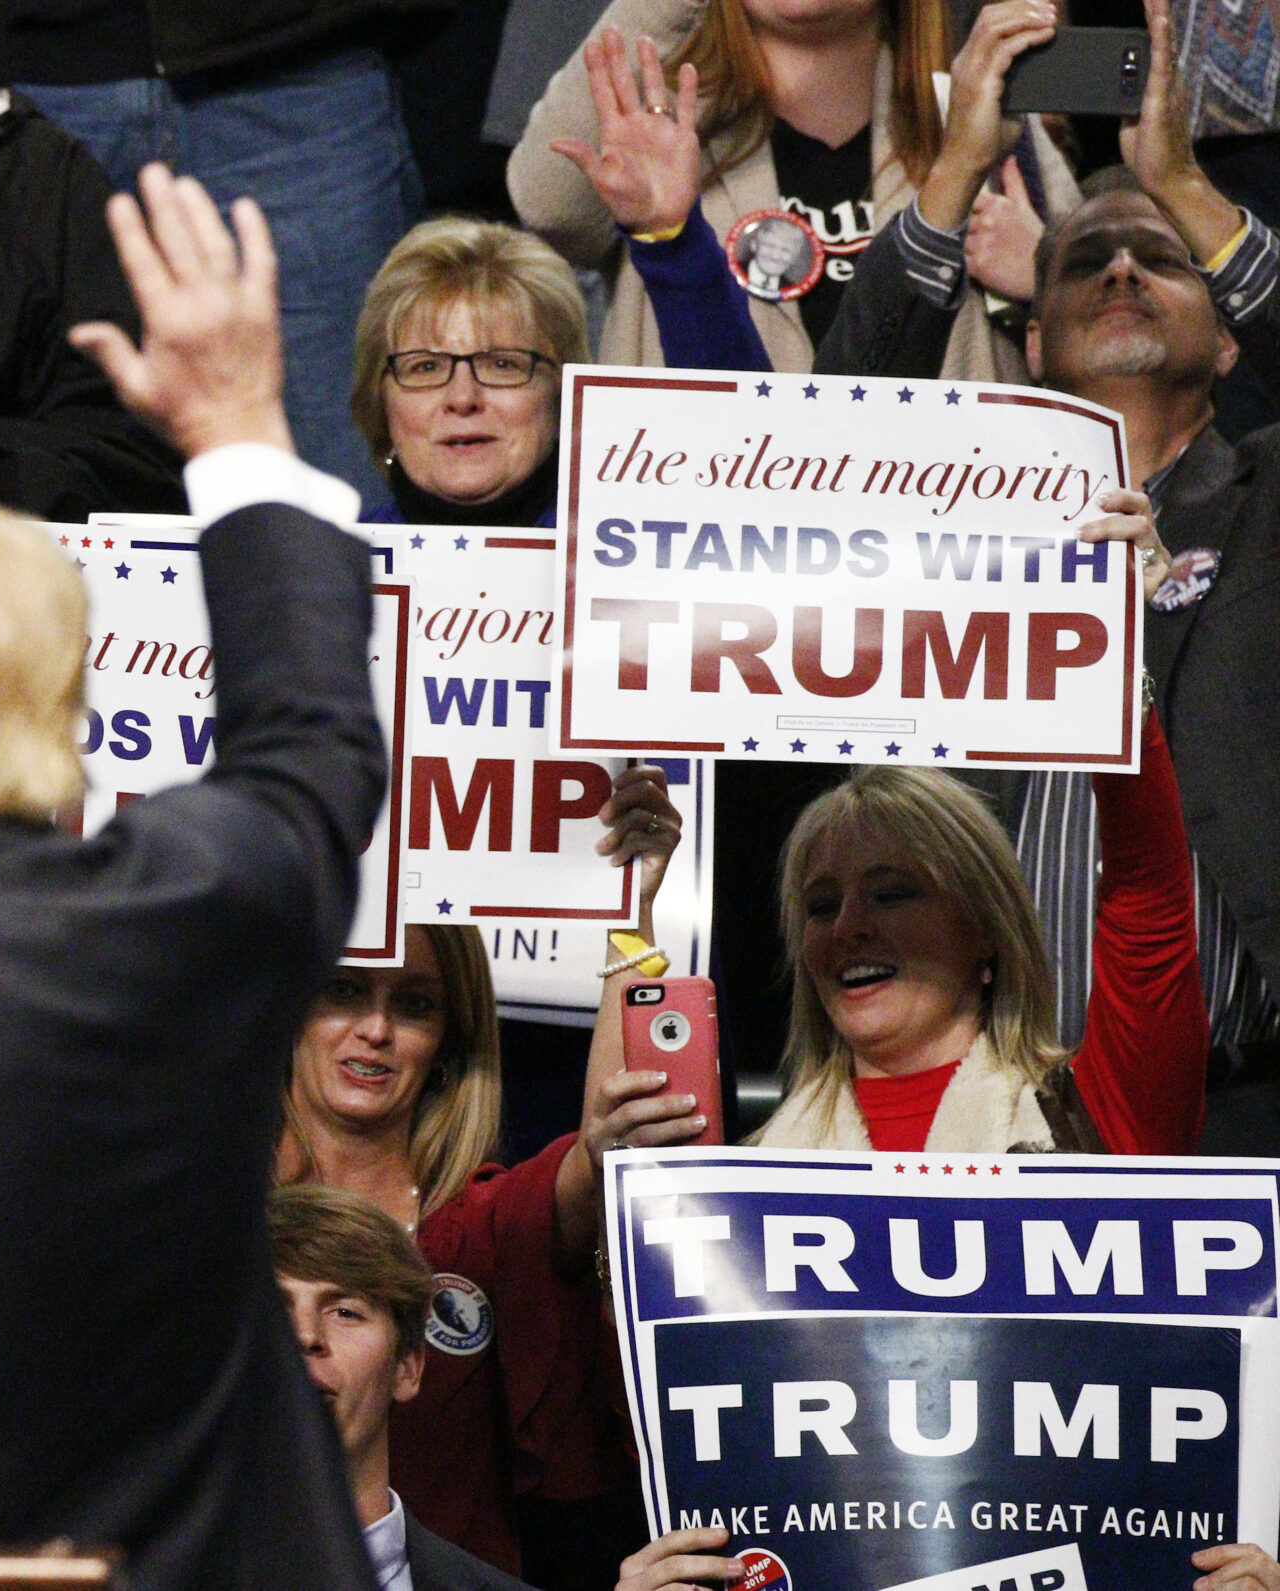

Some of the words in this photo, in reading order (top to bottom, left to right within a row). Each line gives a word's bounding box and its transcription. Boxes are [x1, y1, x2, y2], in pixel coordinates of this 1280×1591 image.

[596, 428, 688, 485] the
[696, 434, 855, 493] silent
[862, 447, 1109, 522] majority
[593, 518, 889, 578] STANDS
[916, 531, 1109, 583] WITH
[591, 598, 1110, 701] TRUMP
[423, 676, 551, 729] WIT
[644, 1214, 1264, 1299] TRUMP
[668, 1380, 1228, 1463] TRUMP
[680, 1504, 770, 1536] MAKE
[783, 1500, 956, 1533] AMERICA
[971, 1501, 1089, 1533] GREAT
[1100, 1506, 1225, 1541] AGAIN!
[744, 1573, 766, 1590] 2016
[745, 1557, 772, 1577] UMP
